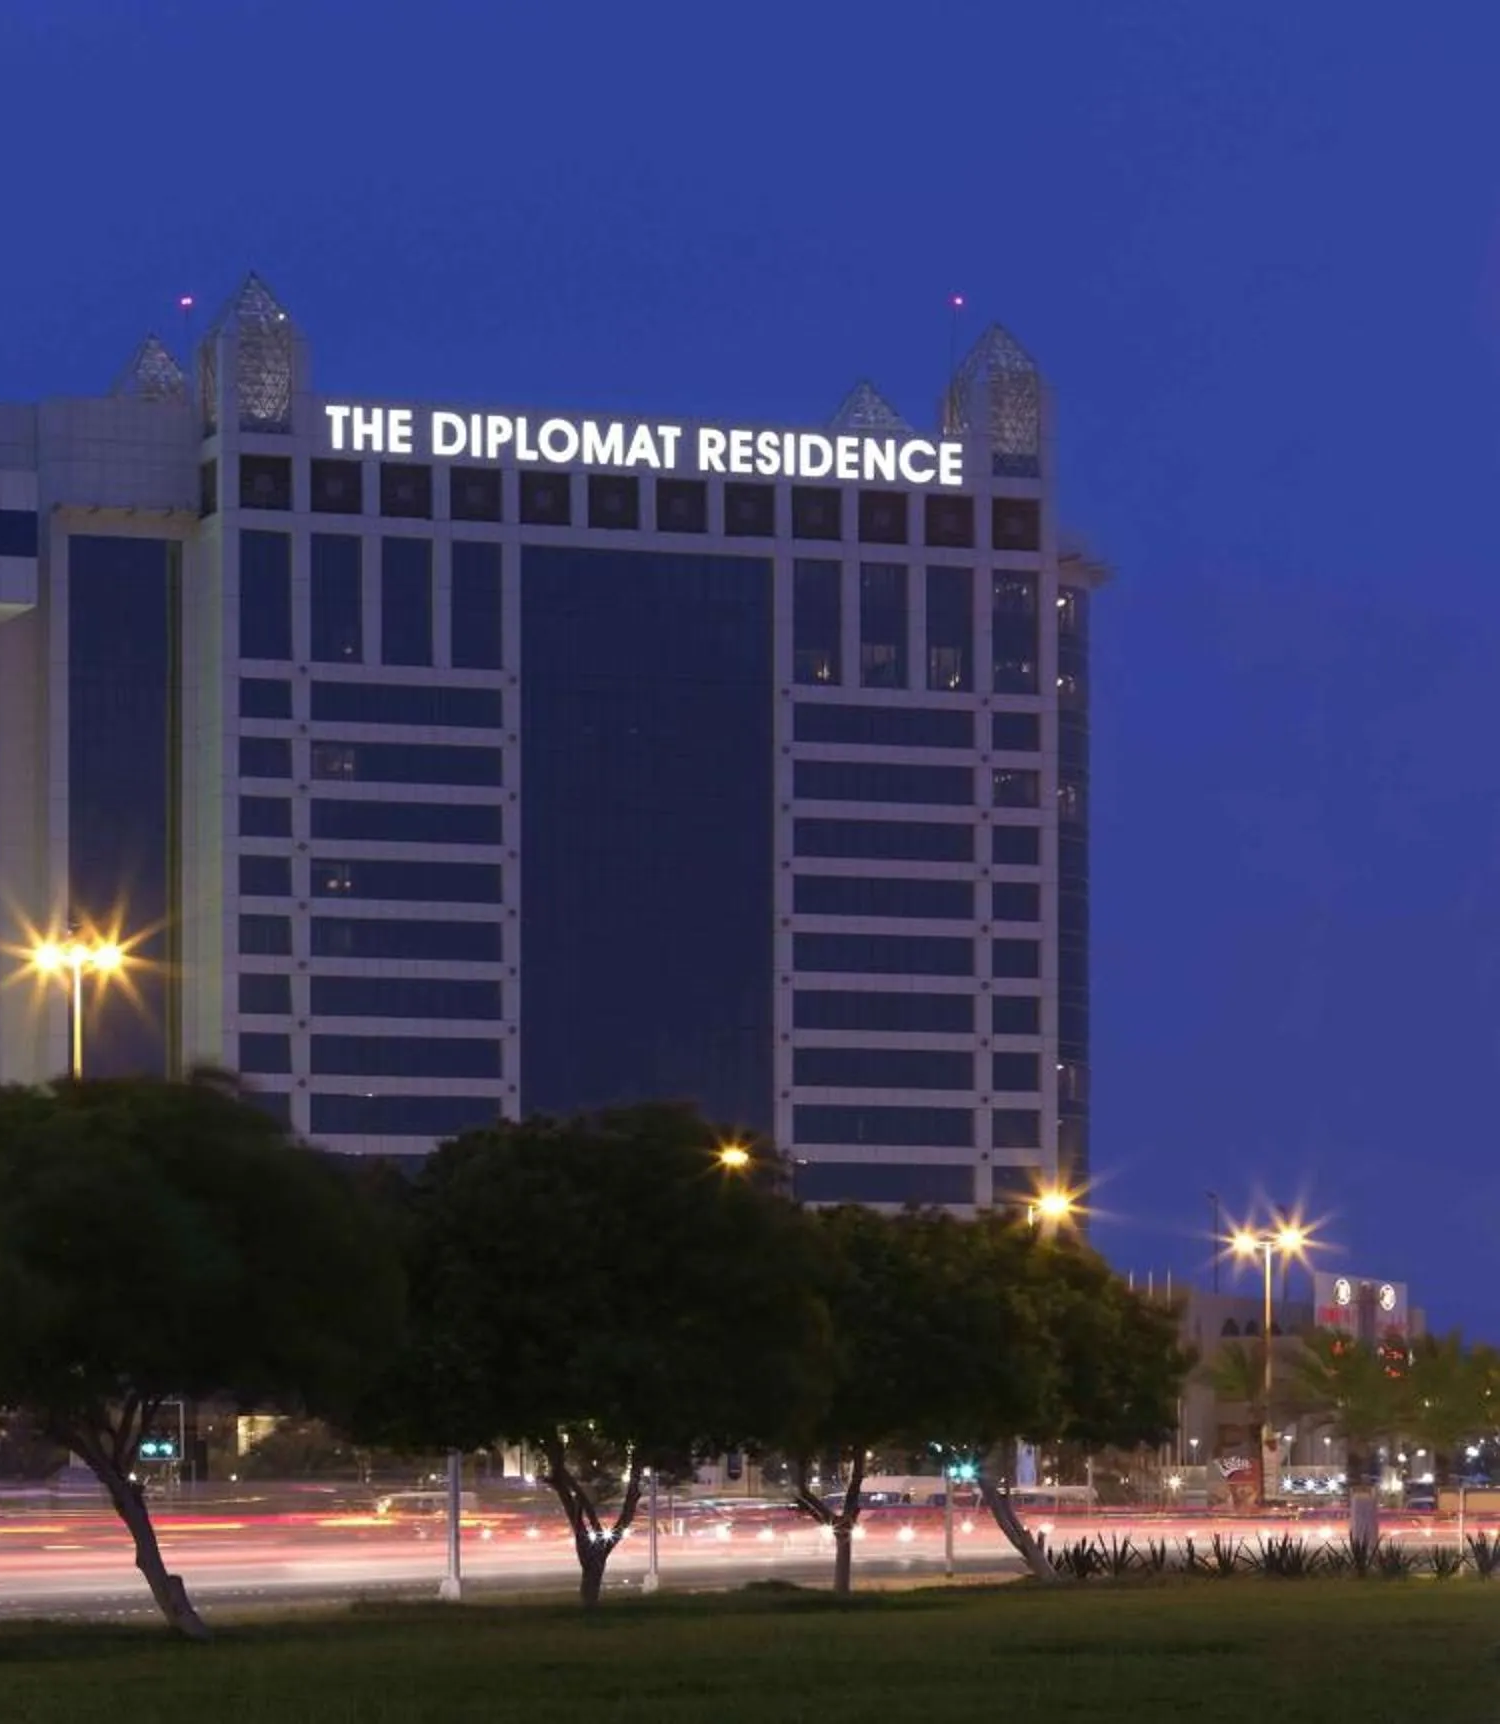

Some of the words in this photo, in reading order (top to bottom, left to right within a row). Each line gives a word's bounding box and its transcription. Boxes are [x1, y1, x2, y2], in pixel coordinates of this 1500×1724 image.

[326, 406, 412, 453] THE
[432, 412, 681, 468] DIPLOMAT
[699, 428, 962, 485] RESIDENCE
